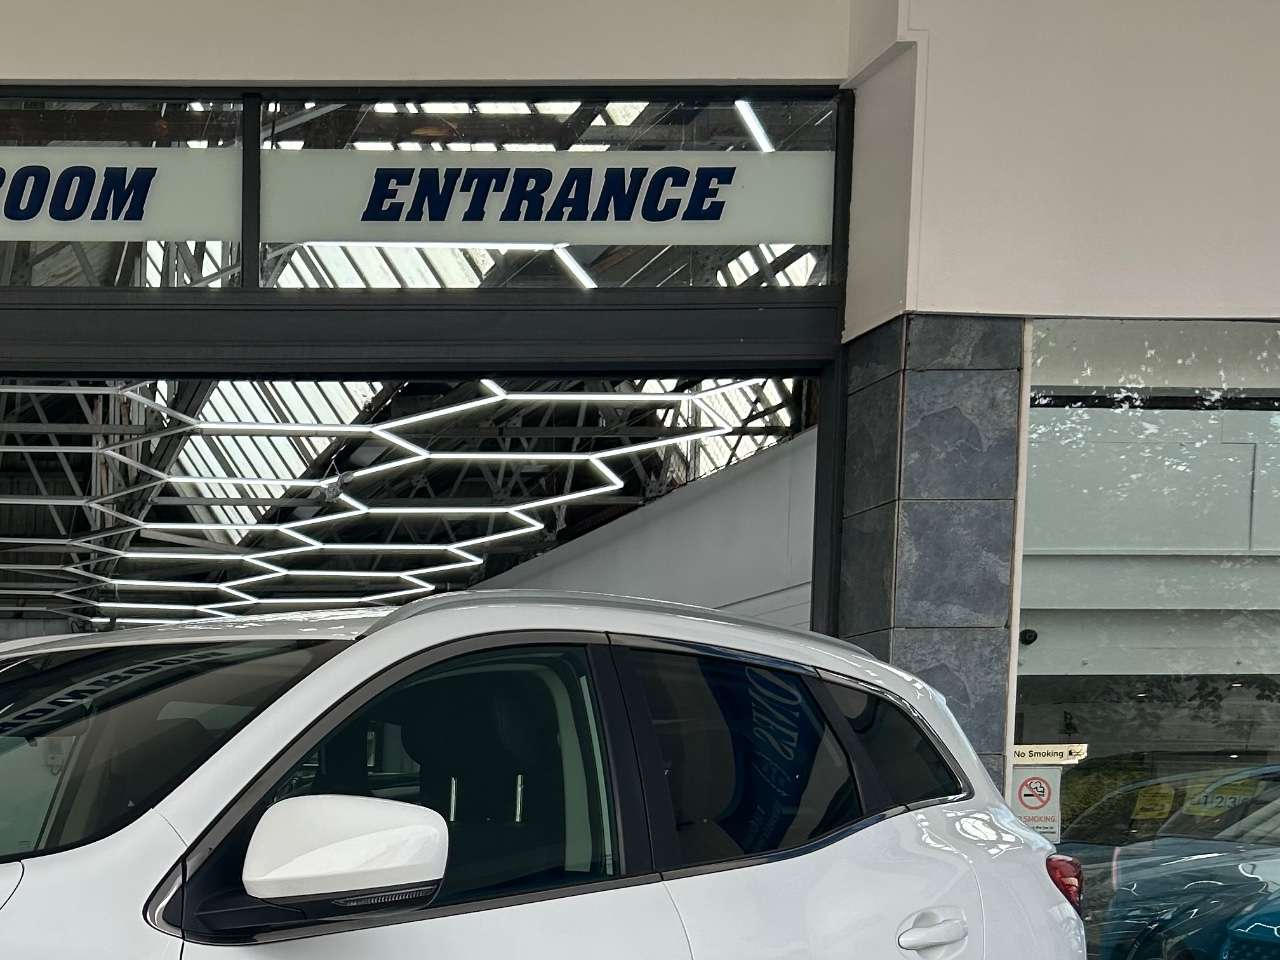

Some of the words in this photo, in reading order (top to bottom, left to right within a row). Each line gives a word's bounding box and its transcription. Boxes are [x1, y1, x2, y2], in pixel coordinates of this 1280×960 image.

[360, 166, 737, 223] ENTRANCE
[1013, 750, 1026, 758] No
[1028, 750, 1064, 759] Smoking
[1023, 815, 1056, 823] SMOKING
